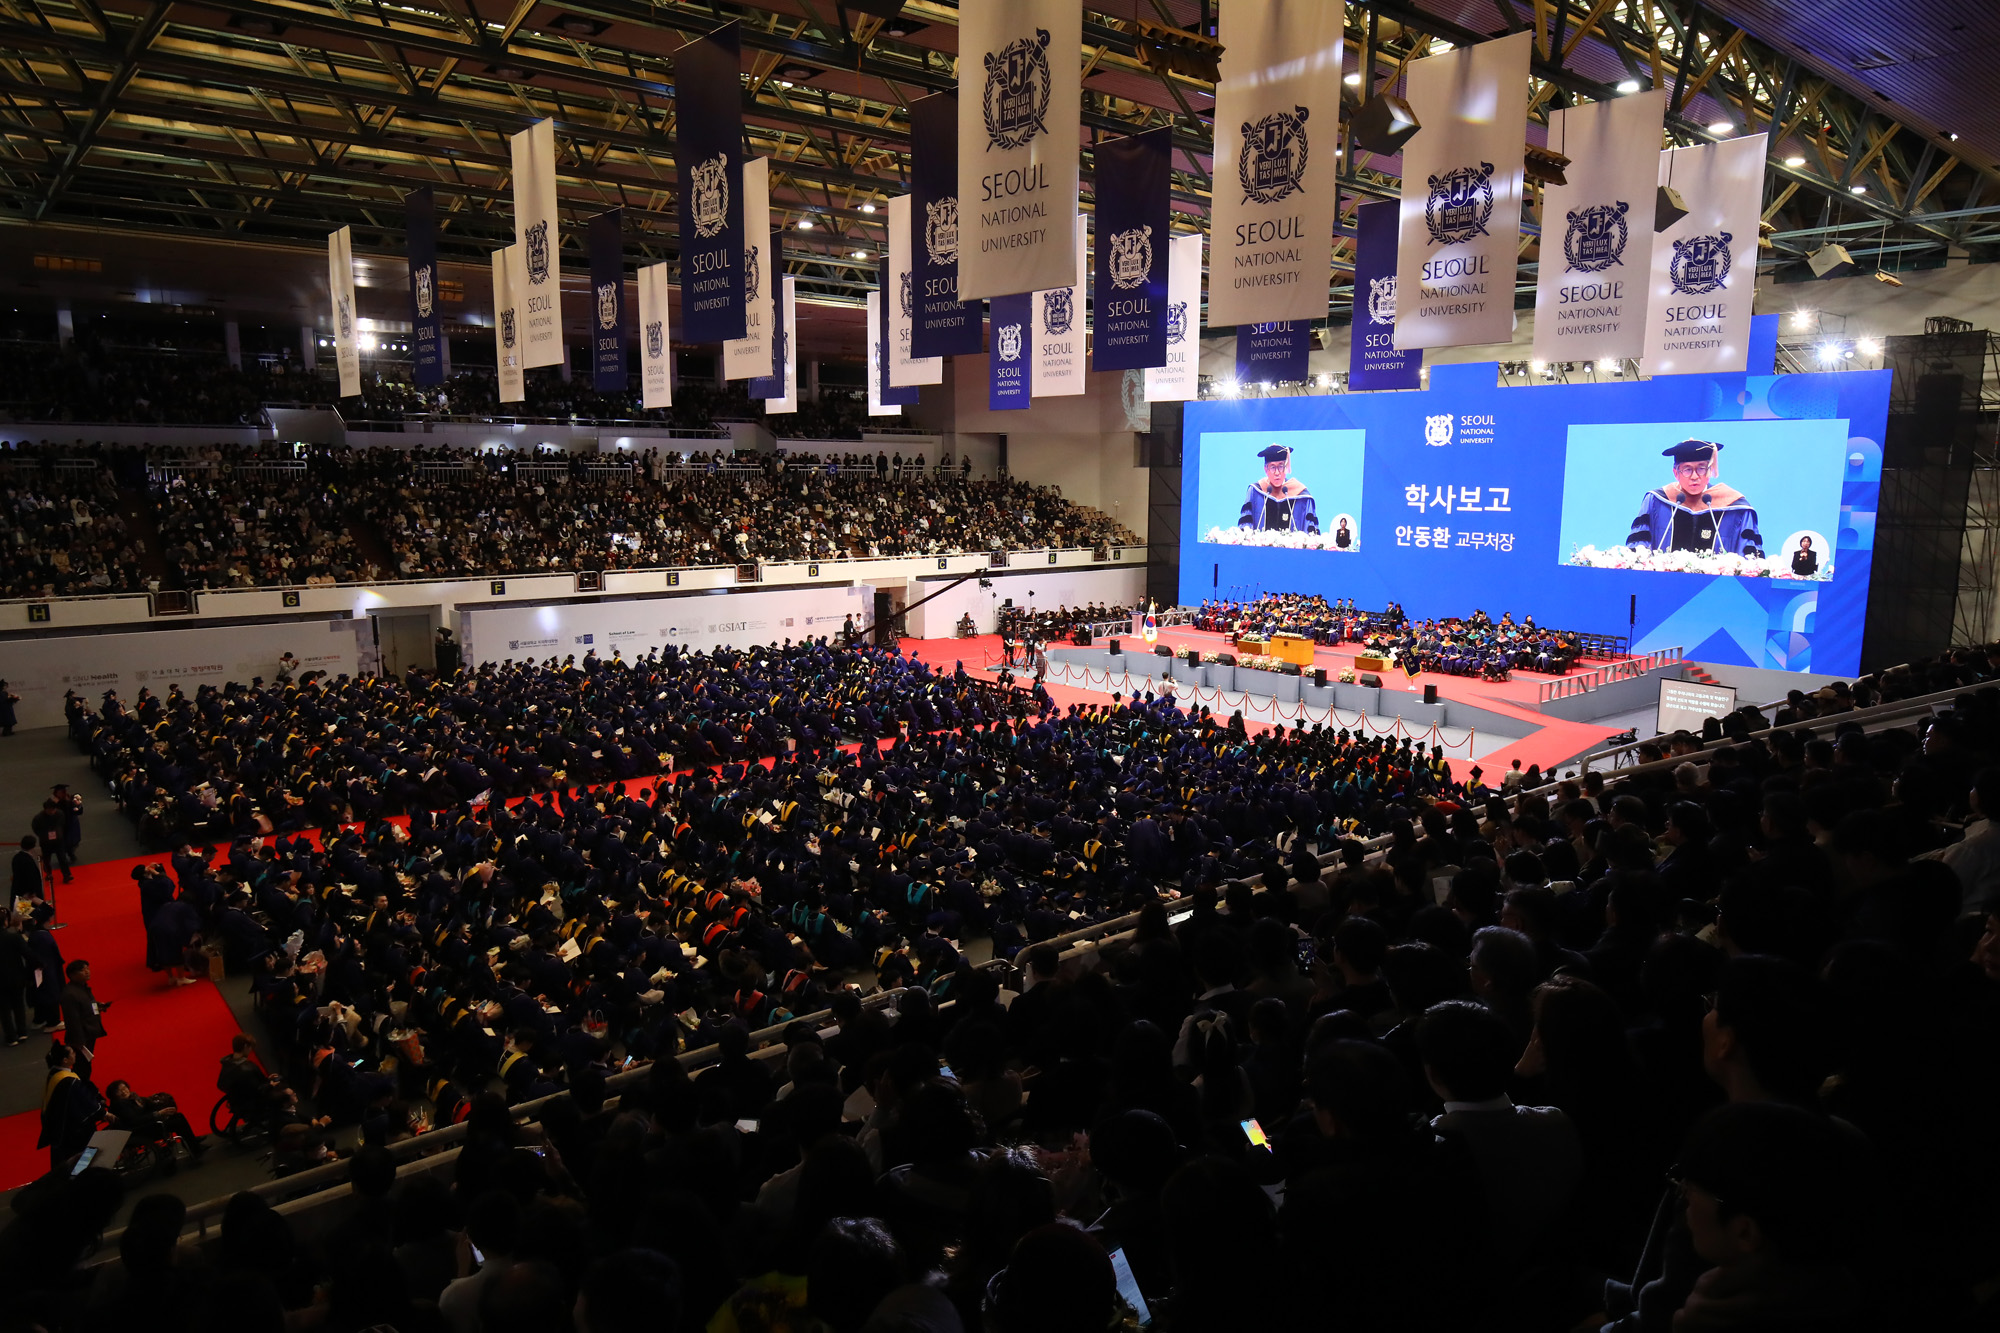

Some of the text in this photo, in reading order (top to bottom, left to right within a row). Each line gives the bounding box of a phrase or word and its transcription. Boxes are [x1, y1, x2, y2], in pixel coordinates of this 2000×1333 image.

[1003, 92, 1030, 109] VERI LUX
[1004, 104, 1030, 120] TAS MEA
[1259, 158, 1286, 170] VERI LUX
[1260, 168, 1286, 179] TAS MEA
[982, 163, 1049, 202] SEOUL
[982, 202, 1047, 228] NATIONAL
[1460, 206, 1472, 214] LUX
[1446, 214, 1472, 224] TAS MEA
[1236, 216, 1304, 246] SEOUL
[982, 228, 1046, 252] UNIVERSITY
[692, 248, 730, 274] SEOUL
[1234, 248, 1302, 269] NATIONAL
[1422, 255, 1489, 281] SEOUL
[694, 278, 730, 293] NATIONAL
[926, 277, 958, 296] SEOU
[1234, 271, 1300, 290] UNIVERSITY
[1420, 282, 1487, 298] NATIONAL
[1559, 281, 1623, 304] SEOUL
[528, 294, 552, 313] SEOUL
[694, 296, 730, 312] UNIVERSITY
[926, 301, 965, 313] NATIONAL
[1108, 298, 1151, 318] SEOUL
[1420, 302, 1485, 318] UNIVERSITY
[1558, 305, 1620, 320] NATIONAL
[1666, 304, 1726, 322] SEOUL
[529, 316, 552, 328] NATIONAL
[926, 317, 965, 329] UNIVERSITY
[1108, 320, 1150, 332] NATIONAL
[1252, 320, 1294, 335] SEOUL
[418, 326, 435, 340] SEOUL
[1557, 322, 1618, 336] UNIVERSITY
[1664, 324, 1724, 336] NATIONAL
[530, 332, 552, 343] UNIVERSITY
[1108, 334, 1150, 346] UNIVERSITY
[1251, 337, 1292, 348] NATIONAL
[1366, 333, 1395, 348] SEOU
[600, 338, 618, 350] SEOUL
[1042, 342, 1072, 356] SEOUL
[1664, 340, 1722, 351] UNIVERSITY
[734, 346, 760, 356] UNIVERSITY
[1250, 350, 1292, 361] UNIVERSITY
[1364, 349, 1406, 360] NATIONAL
[503, 356, 518, 366] SEOUL
[1043, 358, 1072, 367] NATIONAL
[1364, 361, 1405, 371] UNIVERSITY
[648, 366, 664, 375] SEOUL
[998, 368, 1021, 378] SEOUL
[1043, 370, 1072, 378] UNIVERSITY
[1156, 366, 1184, 374] NATIONAL
[1156, 376, 1184, 384] UNIVERSITY
[1460, 415, 1496, 426] SEOUL
[222, 464, 232, 473] G
[1404, 484, 1512, 514] 학사보고
[1396, 525, 1516, 552] 안동환 교무처장
[811, 568, 817, 576] D
[670, 576, 676, 584] E
[495, 585, 501, 594] F
[286, 595, 297, 605] G
[33, 608, 46, 620] H
[719, 622, 747, 632] GSIAT
